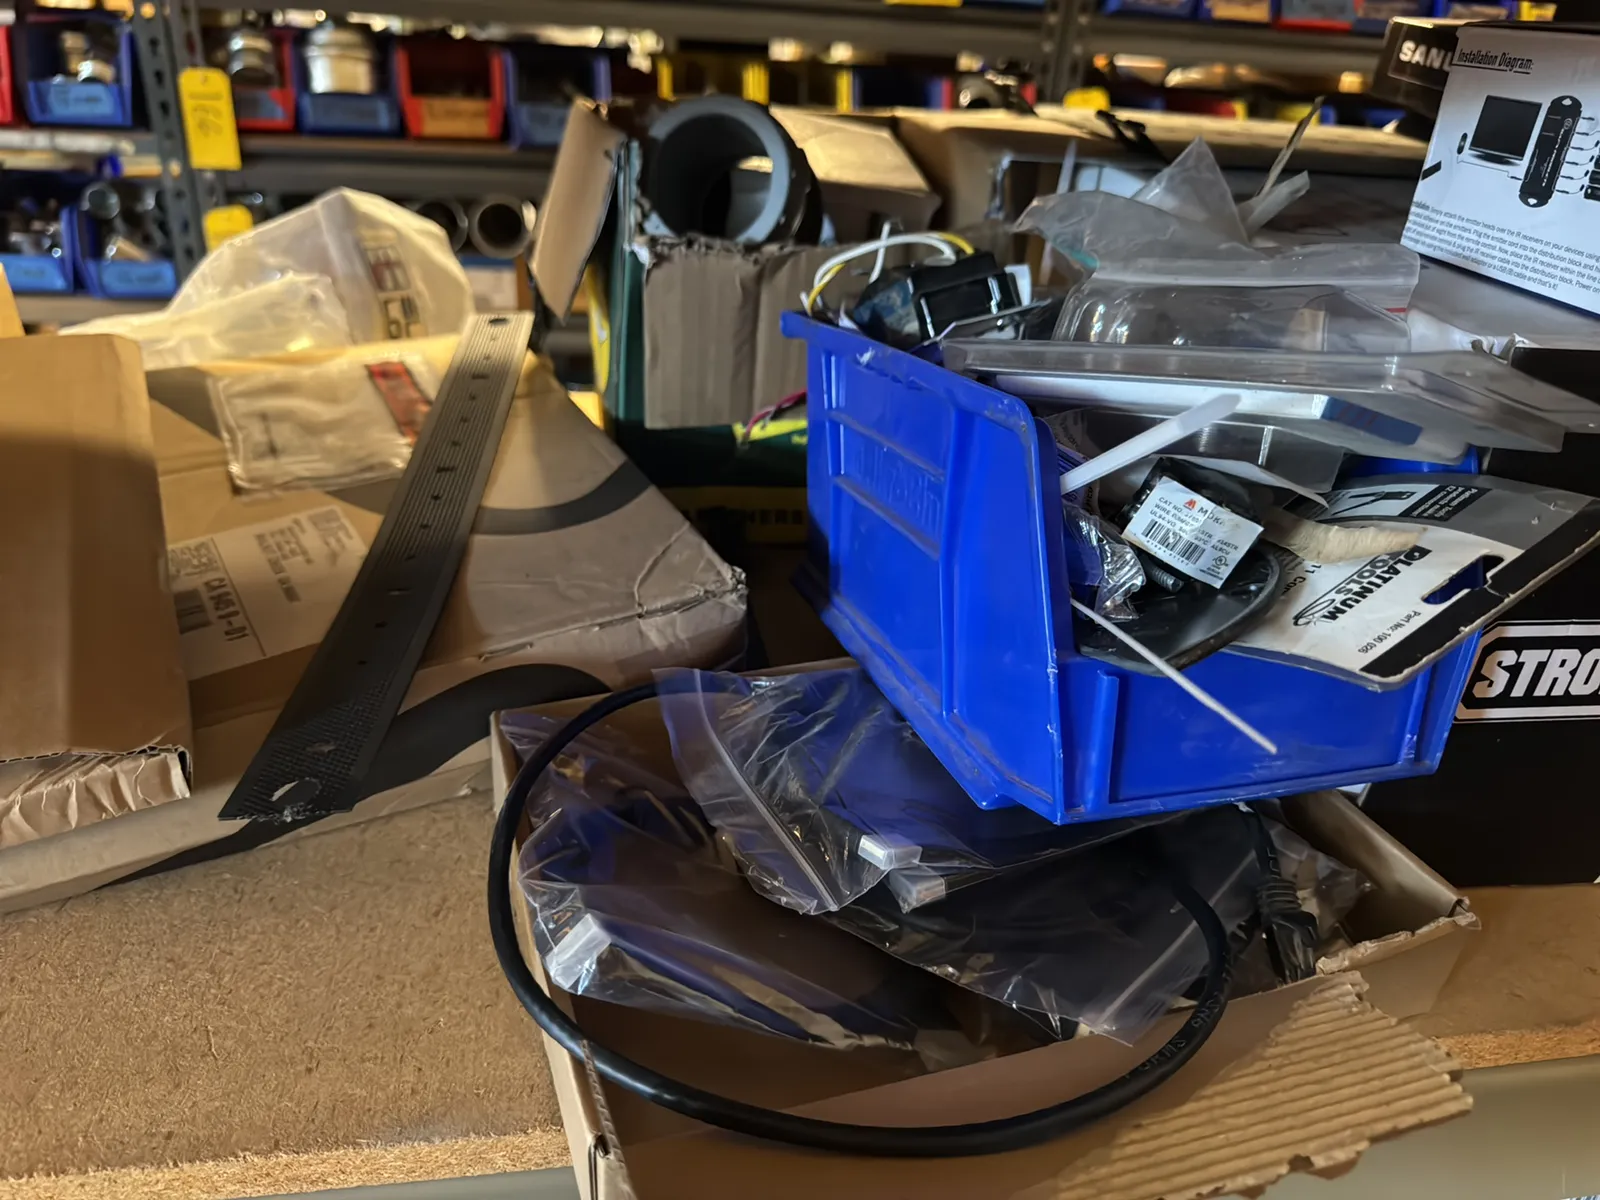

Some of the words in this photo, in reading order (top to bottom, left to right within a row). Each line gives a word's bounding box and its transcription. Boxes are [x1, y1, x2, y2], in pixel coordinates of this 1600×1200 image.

[1458, 48, 1498, 66] Installation
[1498, 52, 1534, 71] Diagram:
[1471, 228, 1483, 239] Plug
[1482, 232, 1491, 240] the
[1490, 233, 1508, 245] emitter
[1507, 239, 1519, 249] cord
[1518, 243, 1529, 251] into
[1528, 245, 1538, 254] the
[1537, 247, 1567, 263] distribution
[1566, 257, 1583, 268] block
[1581, 261, 1594, 271] and
[1495, 226, 1506, 234] over
[1505, 228, 1515, 237] the
[1514, 230, 1521, 238] IR
[1520, 232, 1544, 245] receivers
[1543, 239, 1552, 247] on
[1550, 242, 1564, 252] your
[1563, 244, 1585, 257] devices
[1479, 249, 1498, 261] receiver
[1497, 255, 1511, 265] cable
[1510, 259, 1521, 268] into
[1519, 262, 1530, 271] the
[1528, 264, 1559, 280] distribution
[1557, 274, 1575, 286] block.
[1574, 279, 1593, 291] Power
[1508, 249, 1524, 260] place
[1522, 253, 1533, 262] the
[1531, 256, 1539, 264] IR
[1538, 258, 1560, 271] receiver
[1559, 264, 1576, 276] within
[1575, 270, 1586, 279] the
[1585, 272, 1598, 283] line
[1512, 270, 1527, 280] cable
[1526, 274, 1538, 284] and
[1154, 502, 1170, 515] WIRE
[1158, 496, 1171, 506] CAT
[1322, 544, 1432, 622] PLATINUM
[1334, 550, 1404, 597] TOOLS
[1386, 620, 1405, 633] No:
[1400, 610, 1422, 624] Part
[1372, 631, 1391, 643] 100
[1472, 648, 1600, 698] STRO
